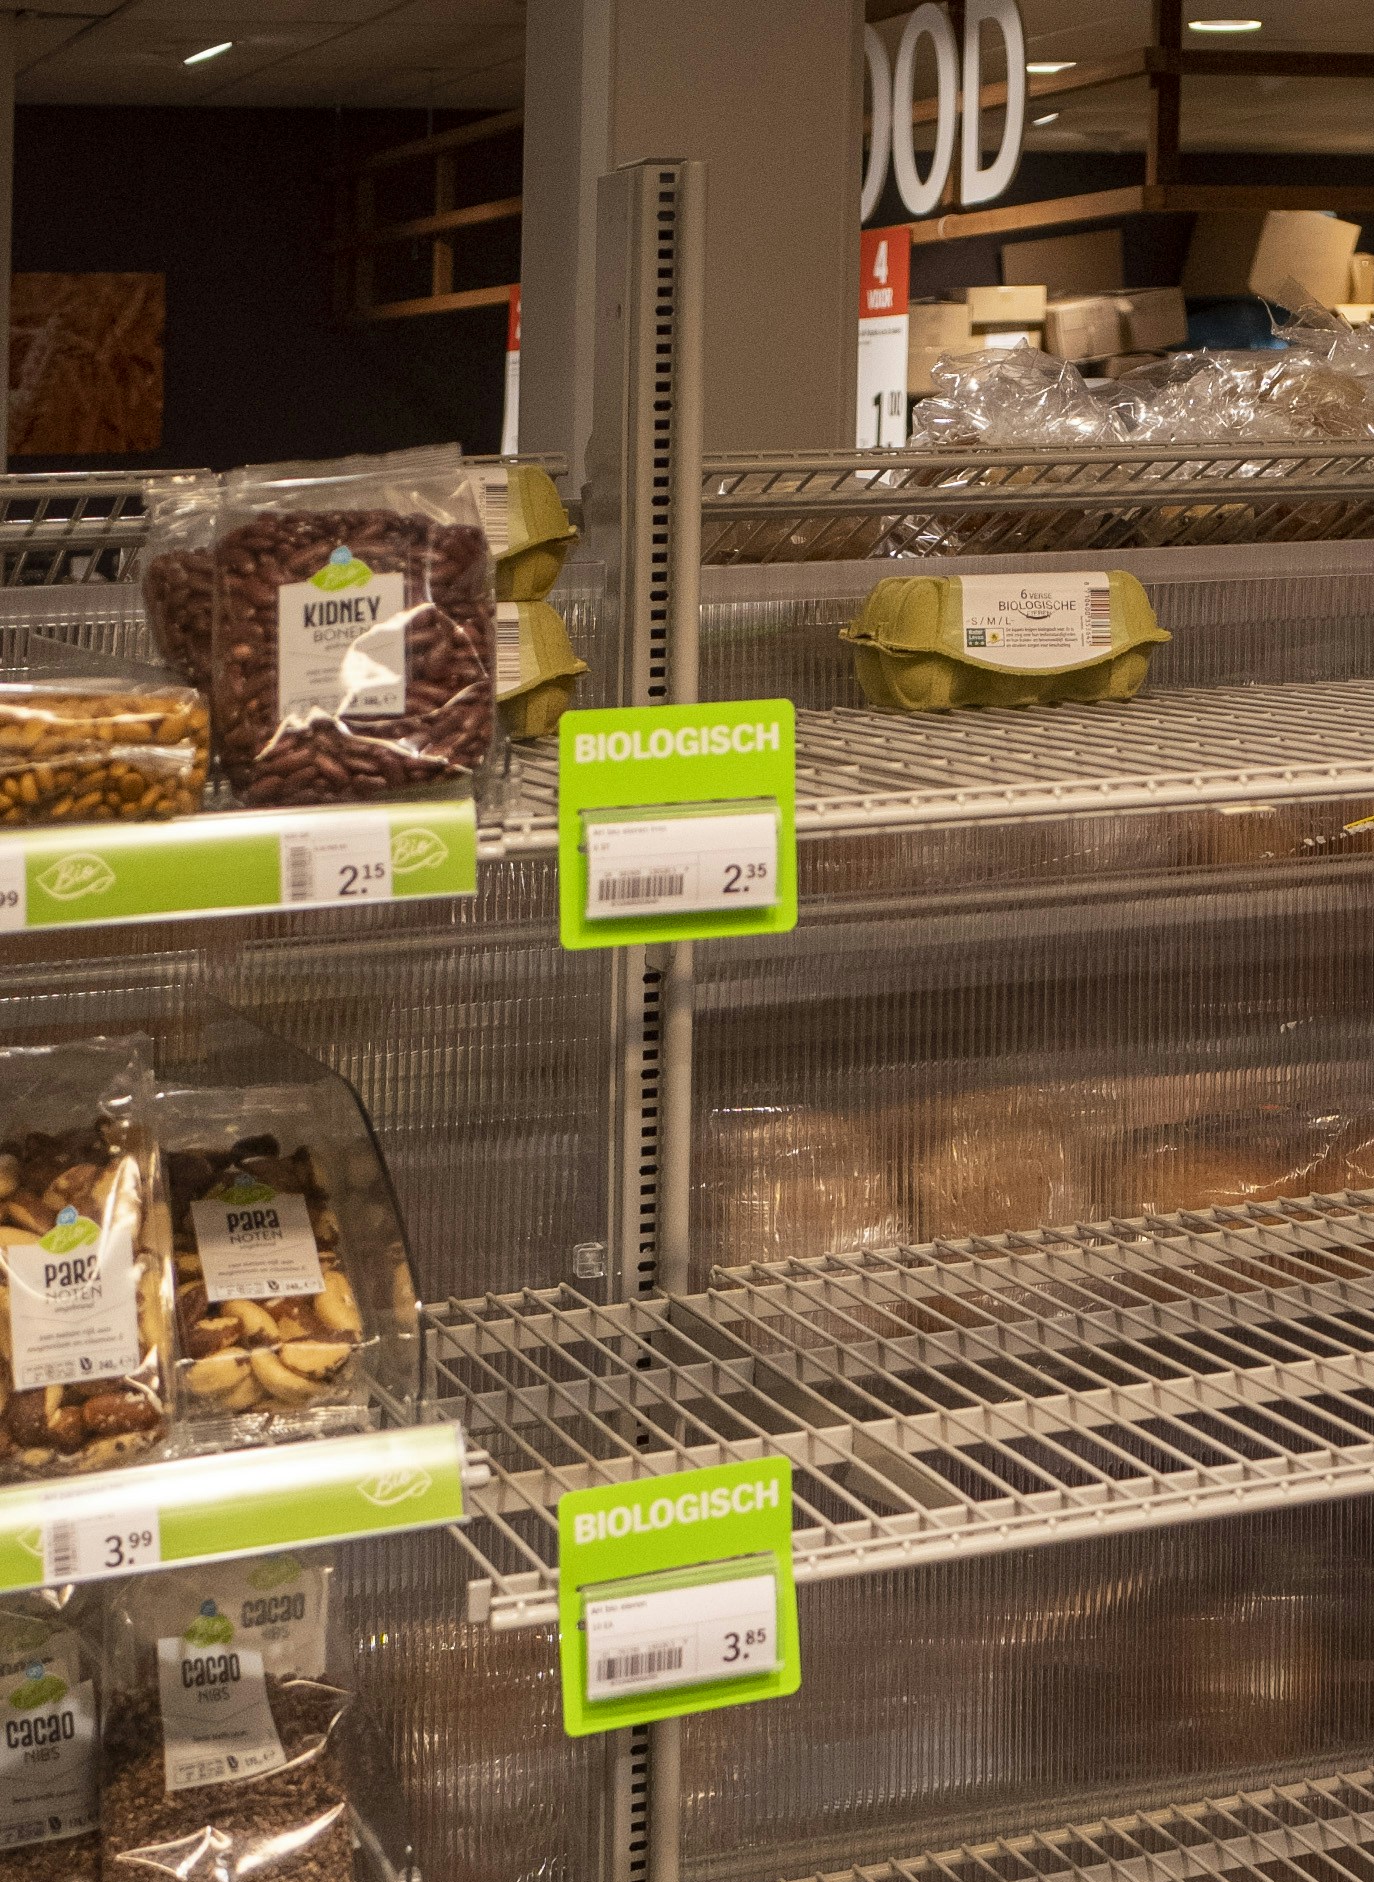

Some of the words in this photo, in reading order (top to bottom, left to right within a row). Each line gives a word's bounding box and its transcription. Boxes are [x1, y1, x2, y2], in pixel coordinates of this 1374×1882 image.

[873, 240, 889, 285] 4
[304, 596, 381, 628] KIDNEY
[998, 600, 1077, 611] BIOLOGISCHE
[574, 721, 780, 764] BIOLOGISCH
[339, 863, 386, 896] 2.15
[722, 863, 768, 893] 2.35
[574, 1478, 779, 1545] BIOLOGISCH
[104, 1531, 153, 1568] 3.99
[723, 1628, 767, 1662] 3.85
